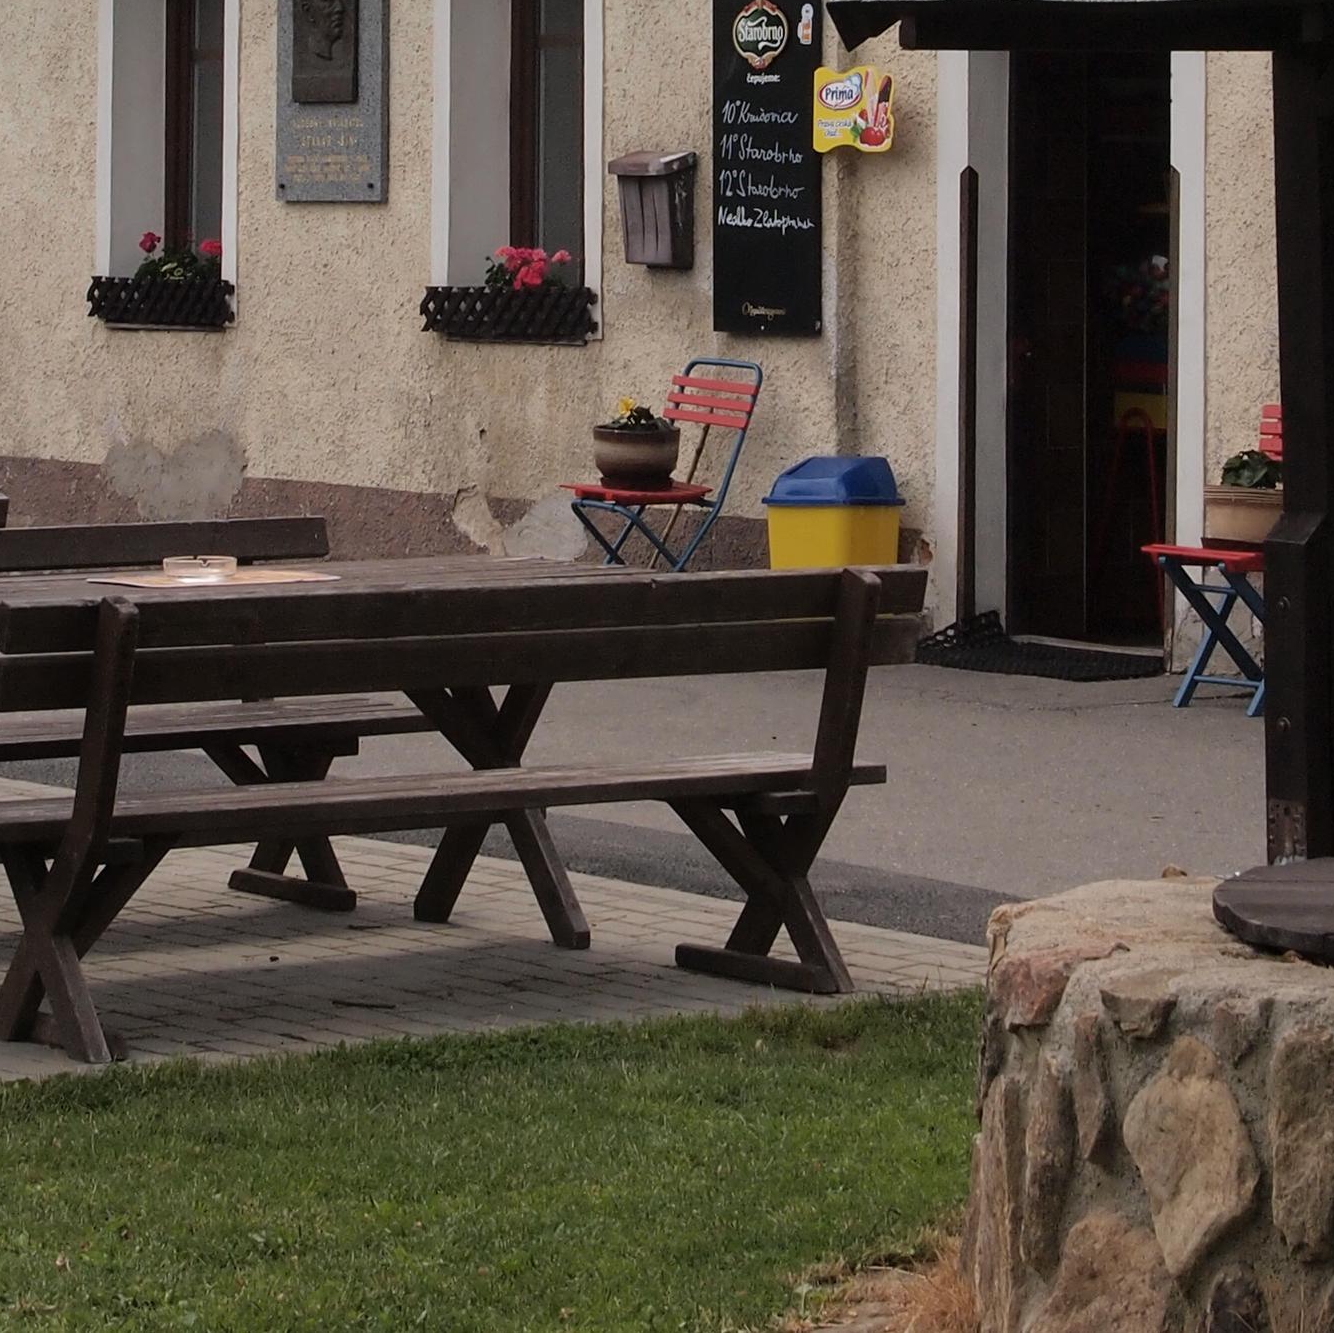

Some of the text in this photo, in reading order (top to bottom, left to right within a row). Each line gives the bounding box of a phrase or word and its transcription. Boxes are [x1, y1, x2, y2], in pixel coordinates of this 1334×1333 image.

[737, 16, 784, 51] Starobrno
[825, 86, 854, 104] Prima
[720, 133, 803, 164] 11° Starobrno
[719, 169, 737, 197] 12°
